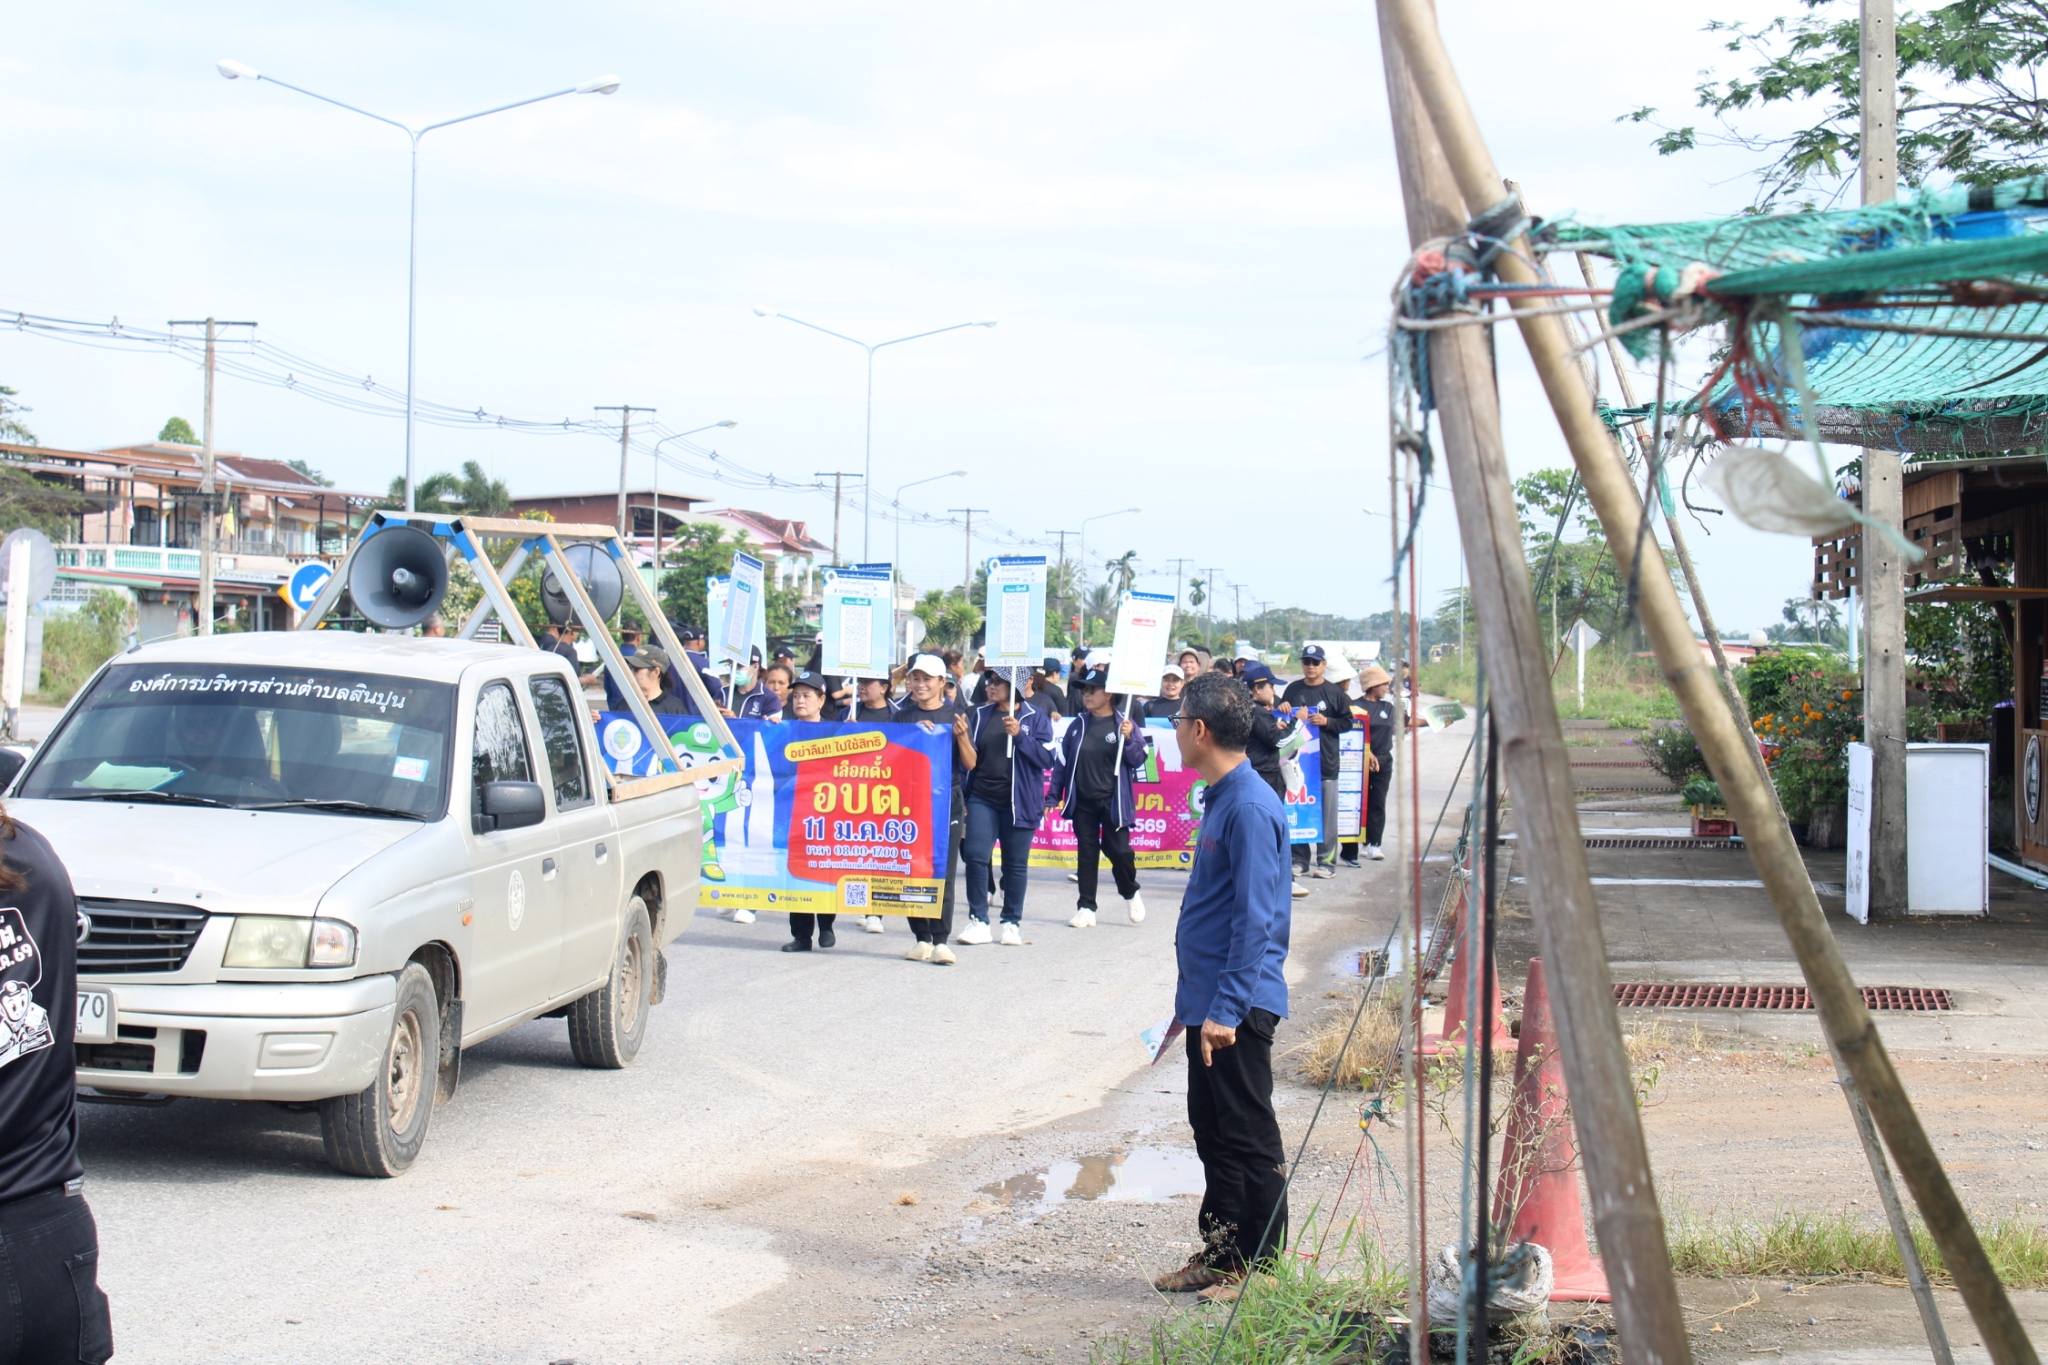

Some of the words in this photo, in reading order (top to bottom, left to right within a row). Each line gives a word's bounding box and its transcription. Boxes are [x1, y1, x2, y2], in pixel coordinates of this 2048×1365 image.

[129, 673, 406, 713] องค์การบริหารส่วนตำบลสินปุน
[790, 744, 831, 759] อย่าลืม!!
[833, 755, 892, 779] เลือกตั้ง
[813, 782, 911, 816] อบต.
[803, 816, 825, 840] 11
[834, 818, 918, 844] ม.ค.69
[1129, 818, 1167, 833] 569
[0, 925, 23, 949] ต.
